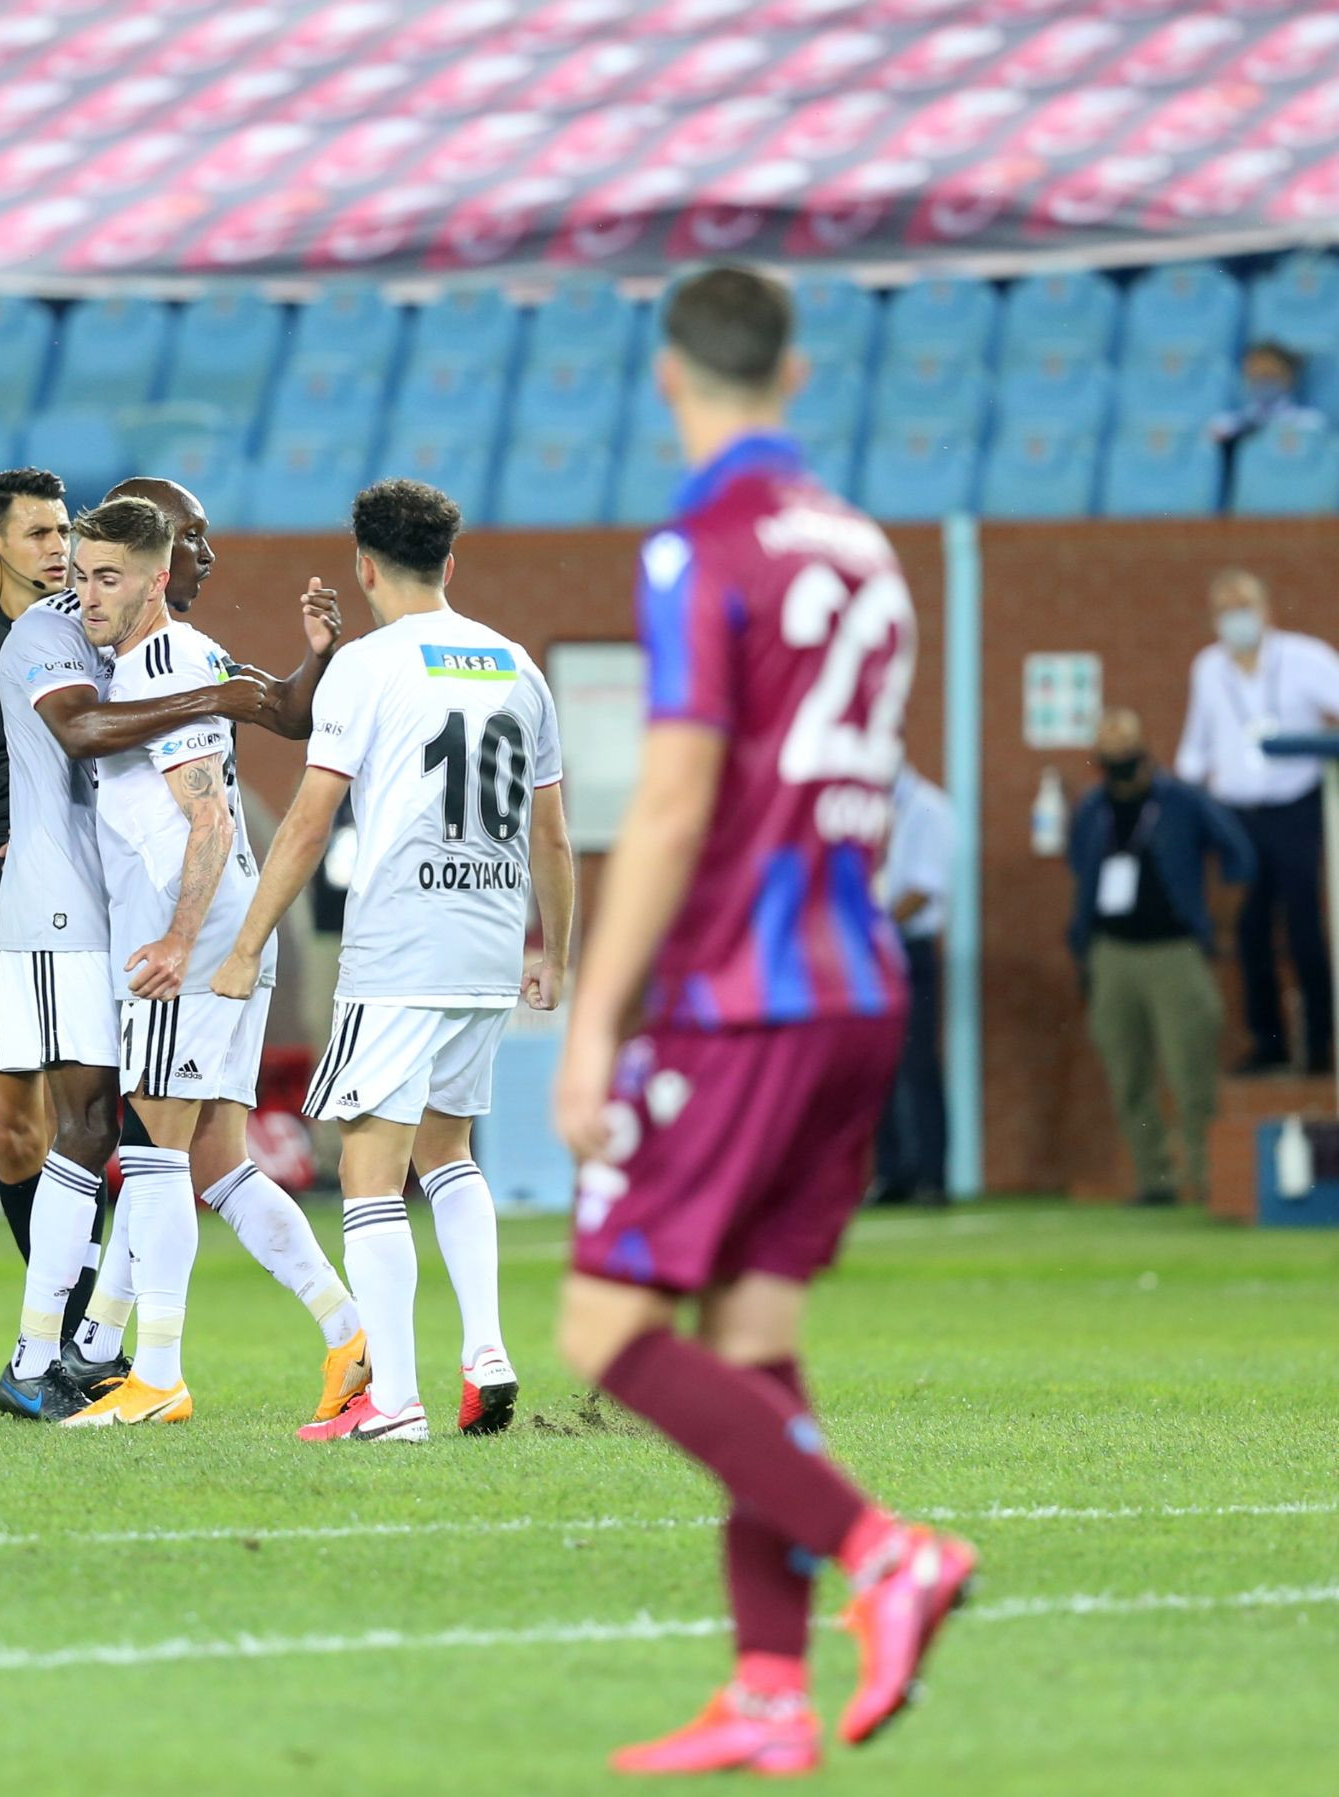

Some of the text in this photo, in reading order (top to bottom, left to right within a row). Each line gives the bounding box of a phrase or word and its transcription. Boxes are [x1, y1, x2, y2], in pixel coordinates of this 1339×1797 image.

[443, 654, 497, 670] aksa
[420, 708, 527, 842] 10
[175, 1070, 203, 1080] adidas
